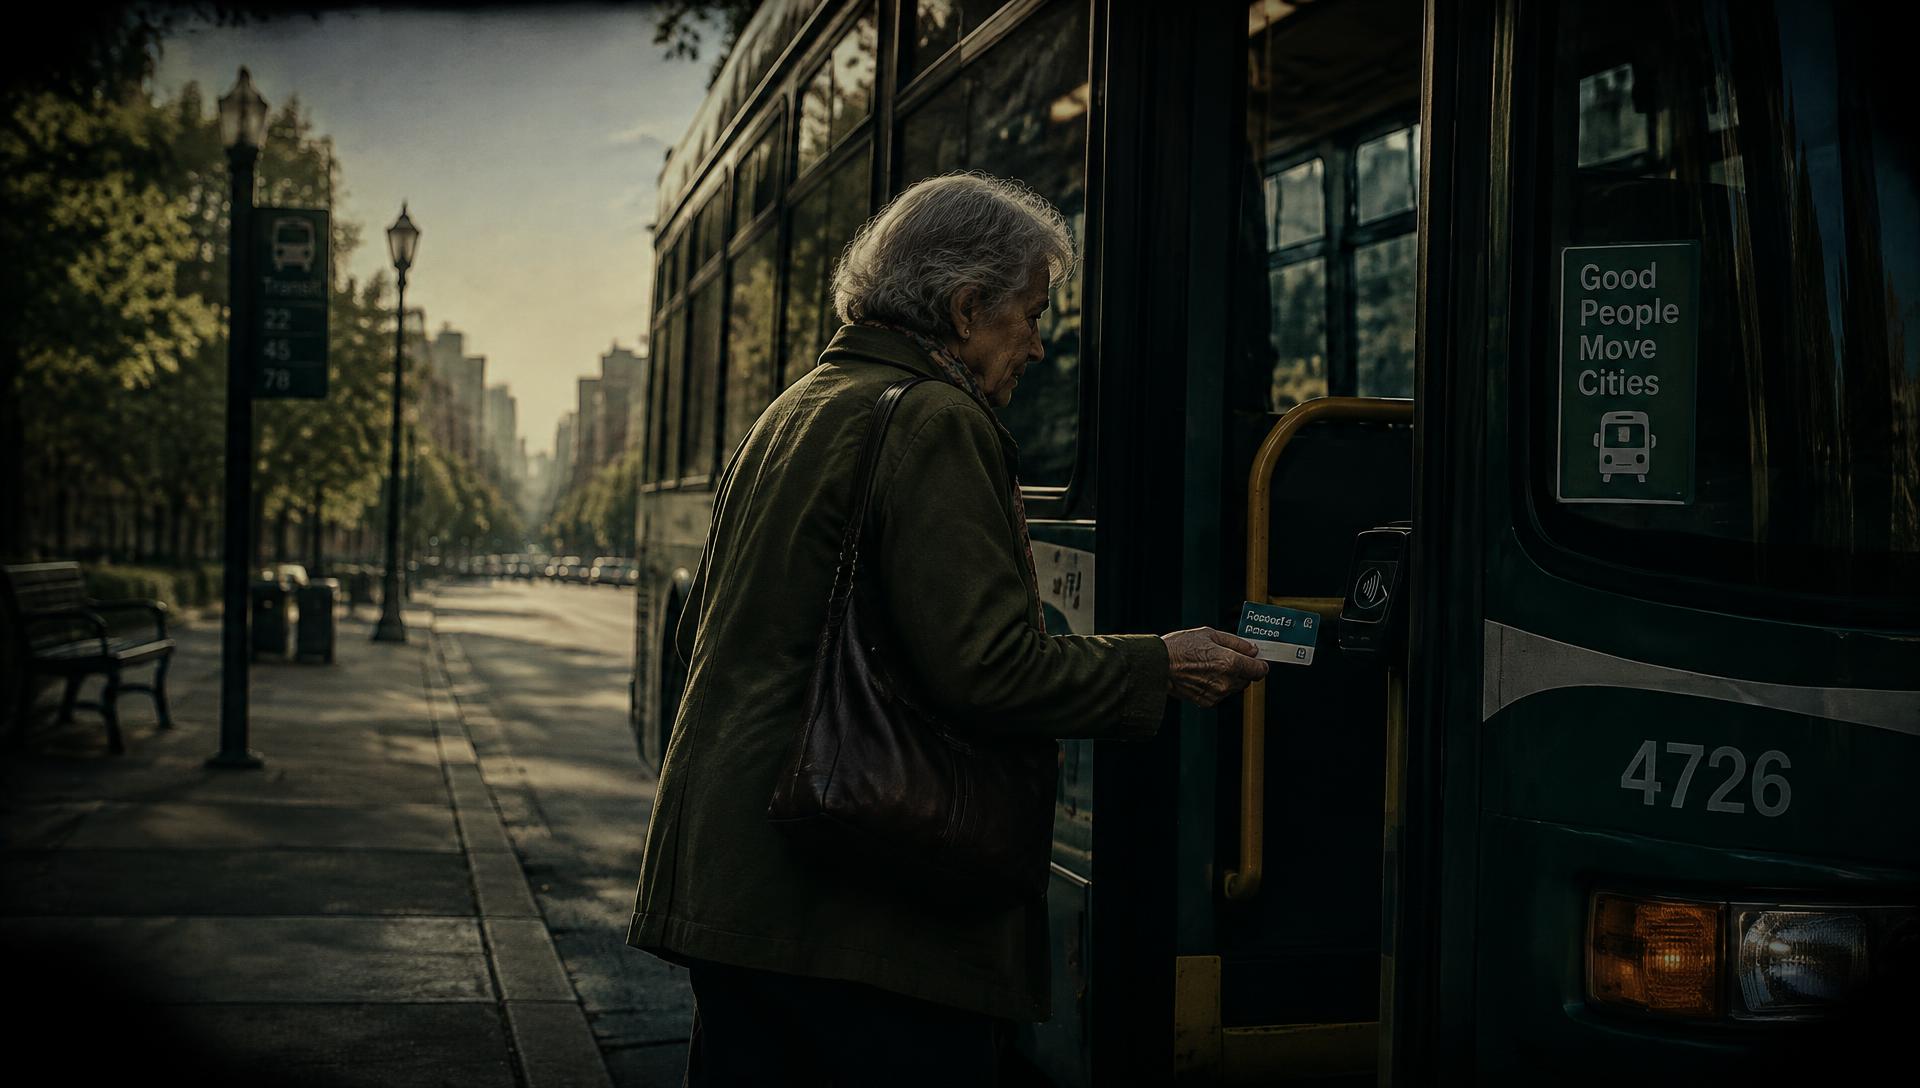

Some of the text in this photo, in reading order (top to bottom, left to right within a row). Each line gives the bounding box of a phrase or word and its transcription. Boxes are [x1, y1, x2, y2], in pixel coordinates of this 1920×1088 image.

[1580, 261, 1657, 291] Good
[263, 308, 291, 330] 22
[1580, 297, 1680, 331] People
[263, 339, 291, 361] 45
[1579, 334, 1657, 361] Move
[263, 368, 291, 391] 78
[1578, 368, 1660, 396] Cities
[1620, 739, 1792, 818] 4726
